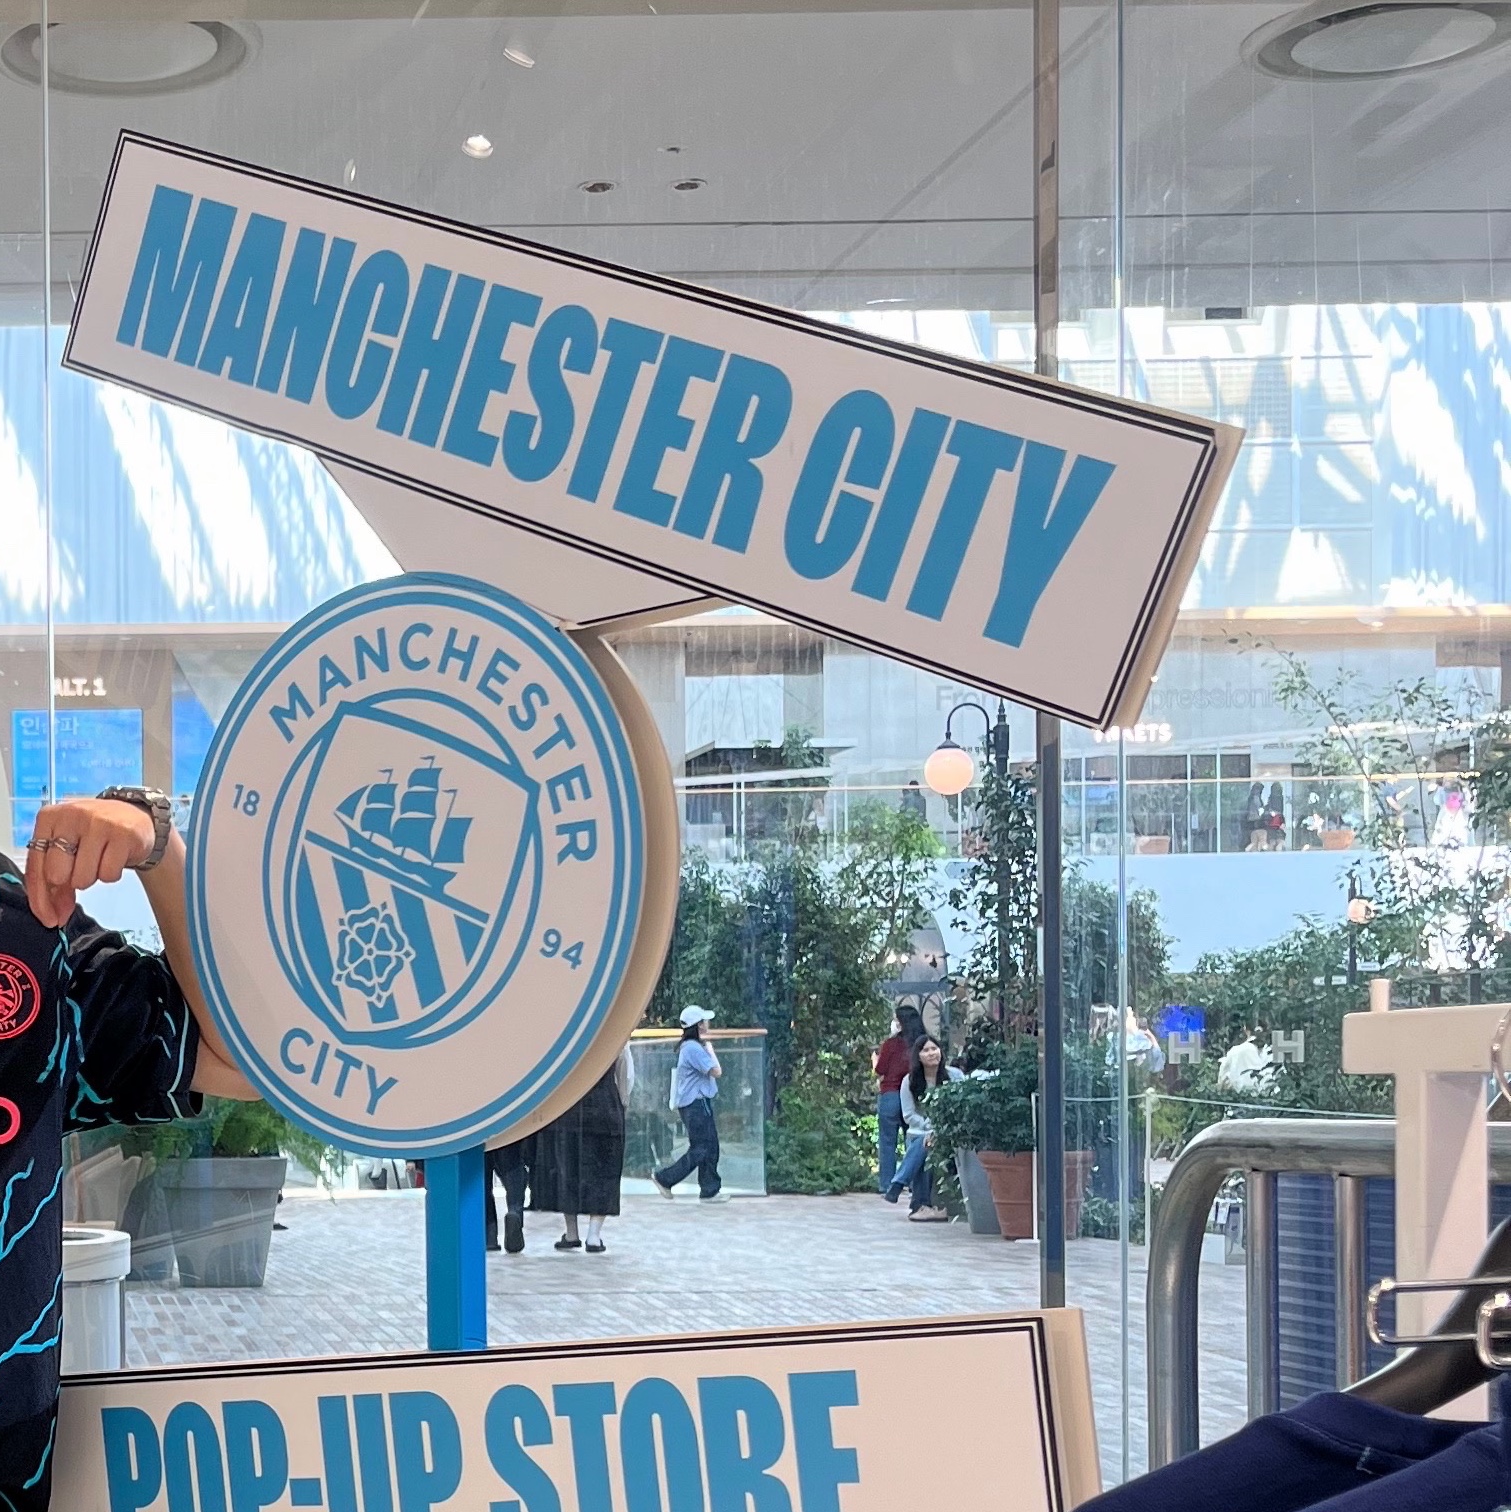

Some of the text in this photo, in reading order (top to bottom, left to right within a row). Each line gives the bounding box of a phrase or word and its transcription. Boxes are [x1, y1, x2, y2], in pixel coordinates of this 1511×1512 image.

[116, 184, 1117, 649] MANCHESTER CITY
[269, 622, 598, 866] MANCHESTER
[232, 783, 261, 818] 18
[539, 927, 586, 970] 94
[279, 1026, 399, 1116] CITY
